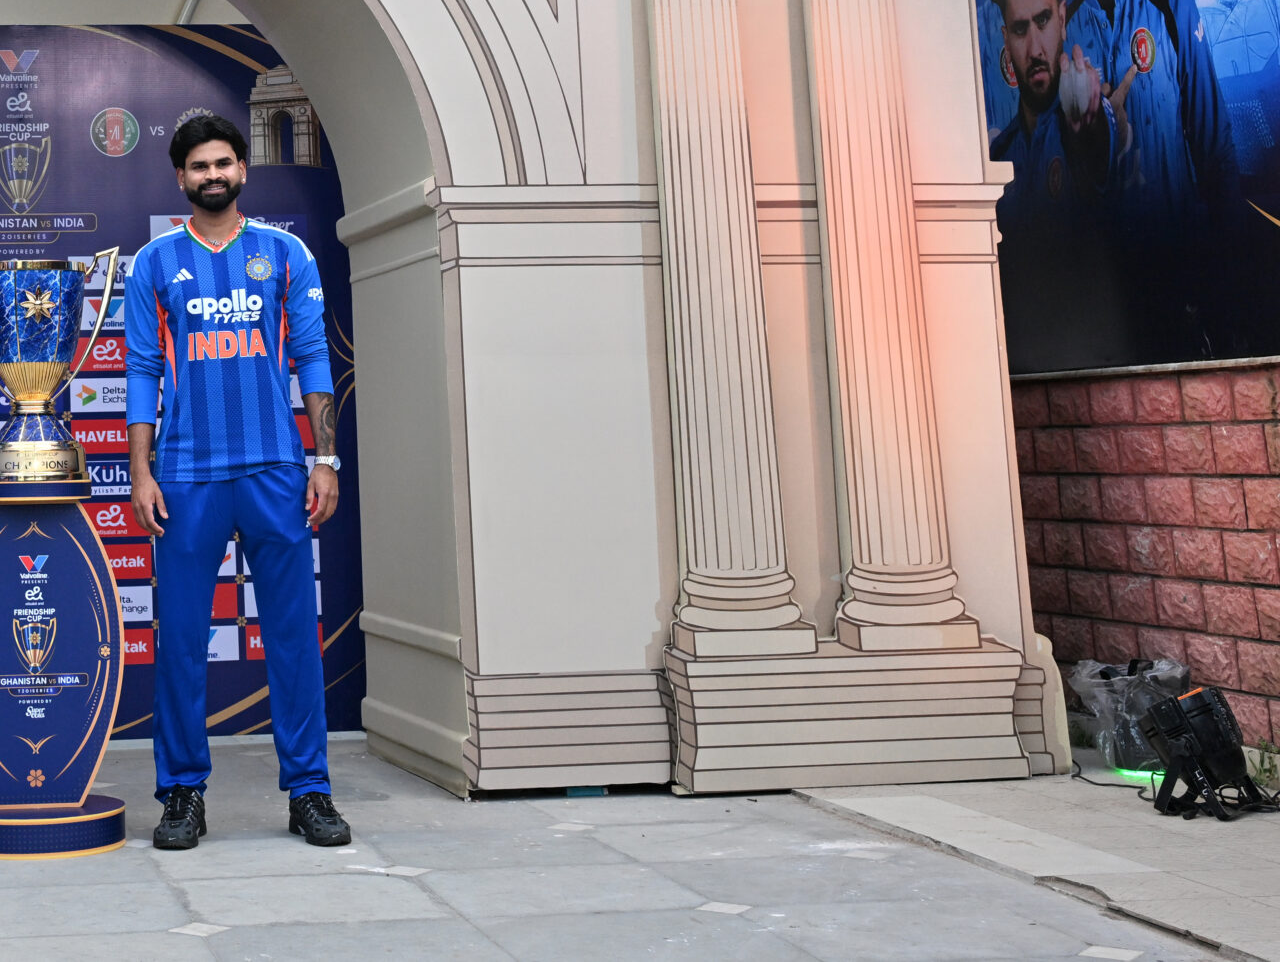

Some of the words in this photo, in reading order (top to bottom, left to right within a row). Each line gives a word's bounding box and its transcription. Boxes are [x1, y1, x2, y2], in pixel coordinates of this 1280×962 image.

[0, 74, 38, 82] Valvoline
[149, 125, 165, 136] VS
[9, 132, 31, 141] CUP
[40, 220, 51, 228] VS
[53, 217, 84, 228] INDIA
[186, 288, 263, 321] apollo
[213, 311, 261, 324] TYRES
[187, 328, 268, 362] INDIA
[75, 430, 129, 443] HAVEL
[87, 464, 132, 483] Küh
[19, 572, 48, 580] Valvoline
[13, 608, 56, 616] FRIENDSHIP
[121, 604, 149, 615] hange
[58, 676, 80, 684] INDIA
